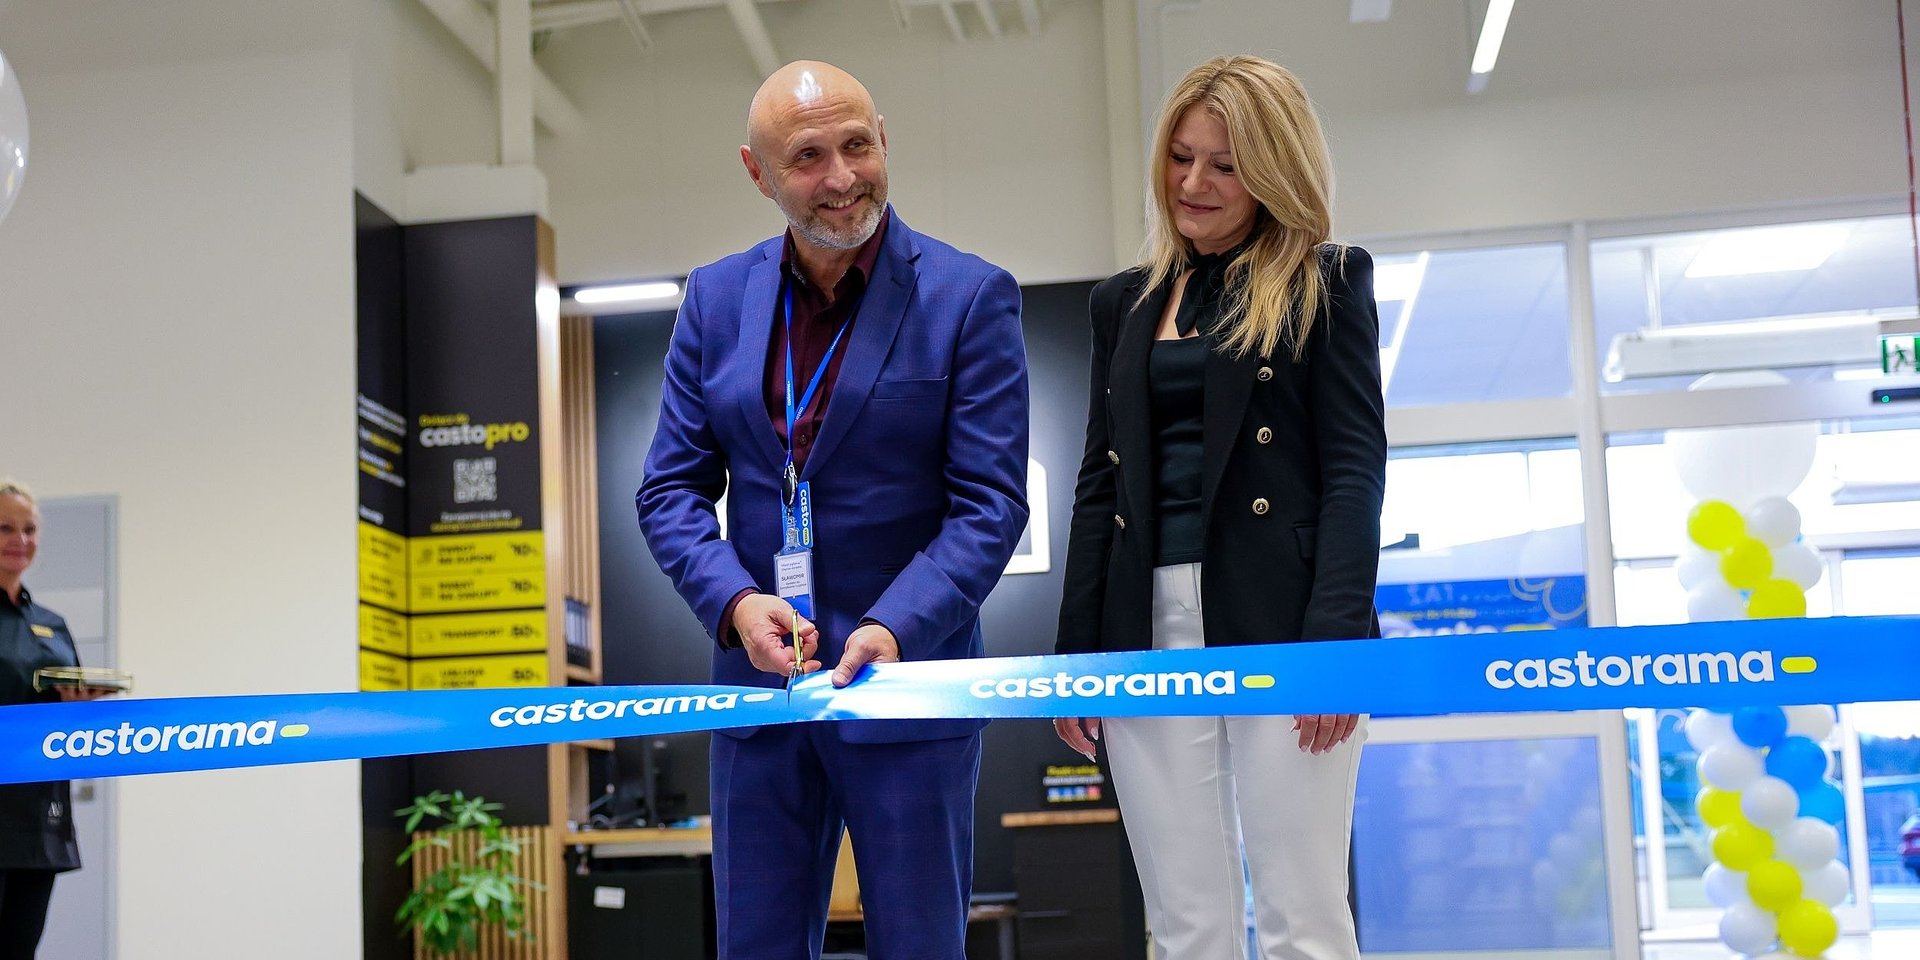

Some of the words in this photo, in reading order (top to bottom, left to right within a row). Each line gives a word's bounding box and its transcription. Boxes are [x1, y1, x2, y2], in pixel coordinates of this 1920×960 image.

[420, 422, 529, 450] castopro
[800, 489, 809, 527] casto
[968, 670, 1235, 699] castorama
[1485, 650, 1775, 689] castorama
[489, 692, 739, 728] castorama
[42, 720, 277, 759] castorama
